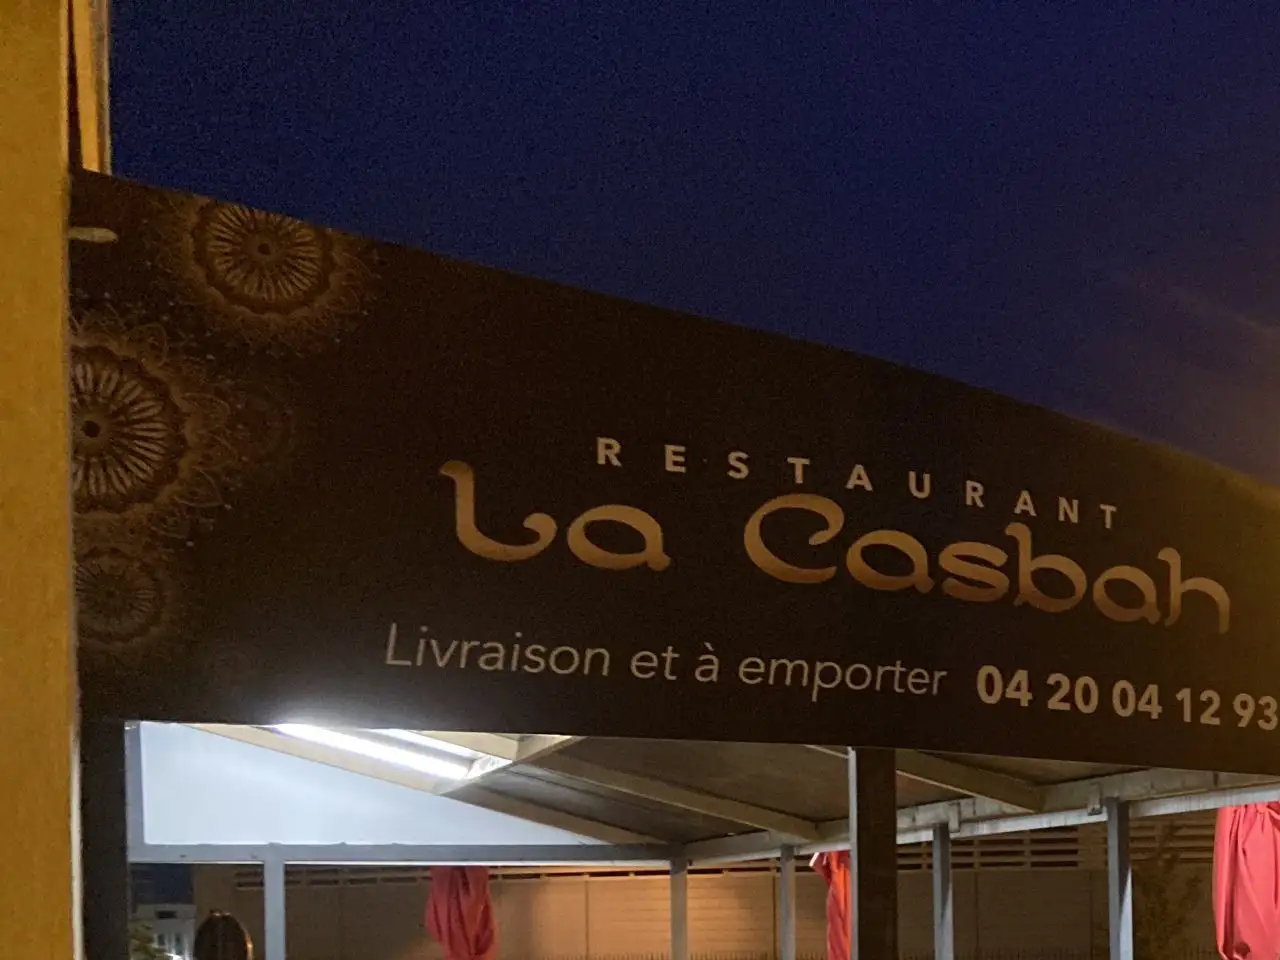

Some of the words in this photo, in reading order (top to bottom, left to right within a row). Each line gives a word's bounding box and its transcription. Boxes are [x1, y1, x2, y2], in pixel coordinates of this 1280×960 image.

[597, 437, 1118, 530] RESTAURANT
[439, 461, 671, 571] La
[743, 493, 1231, 634] Casbah
[385, 622, 611, 677] Livraison
[629, 646, 679, 681] et
[694, 642, 720, 683] à
[737, 655, 947, 701] emporter
[976, 664, 1033, 708] 04
[1045, 674, 1100, 715] 20
[1111, 679, 1163, 721] 04
[1176, 687, 1222, 726] 12
[1232, 693, 1279, 732] 93
